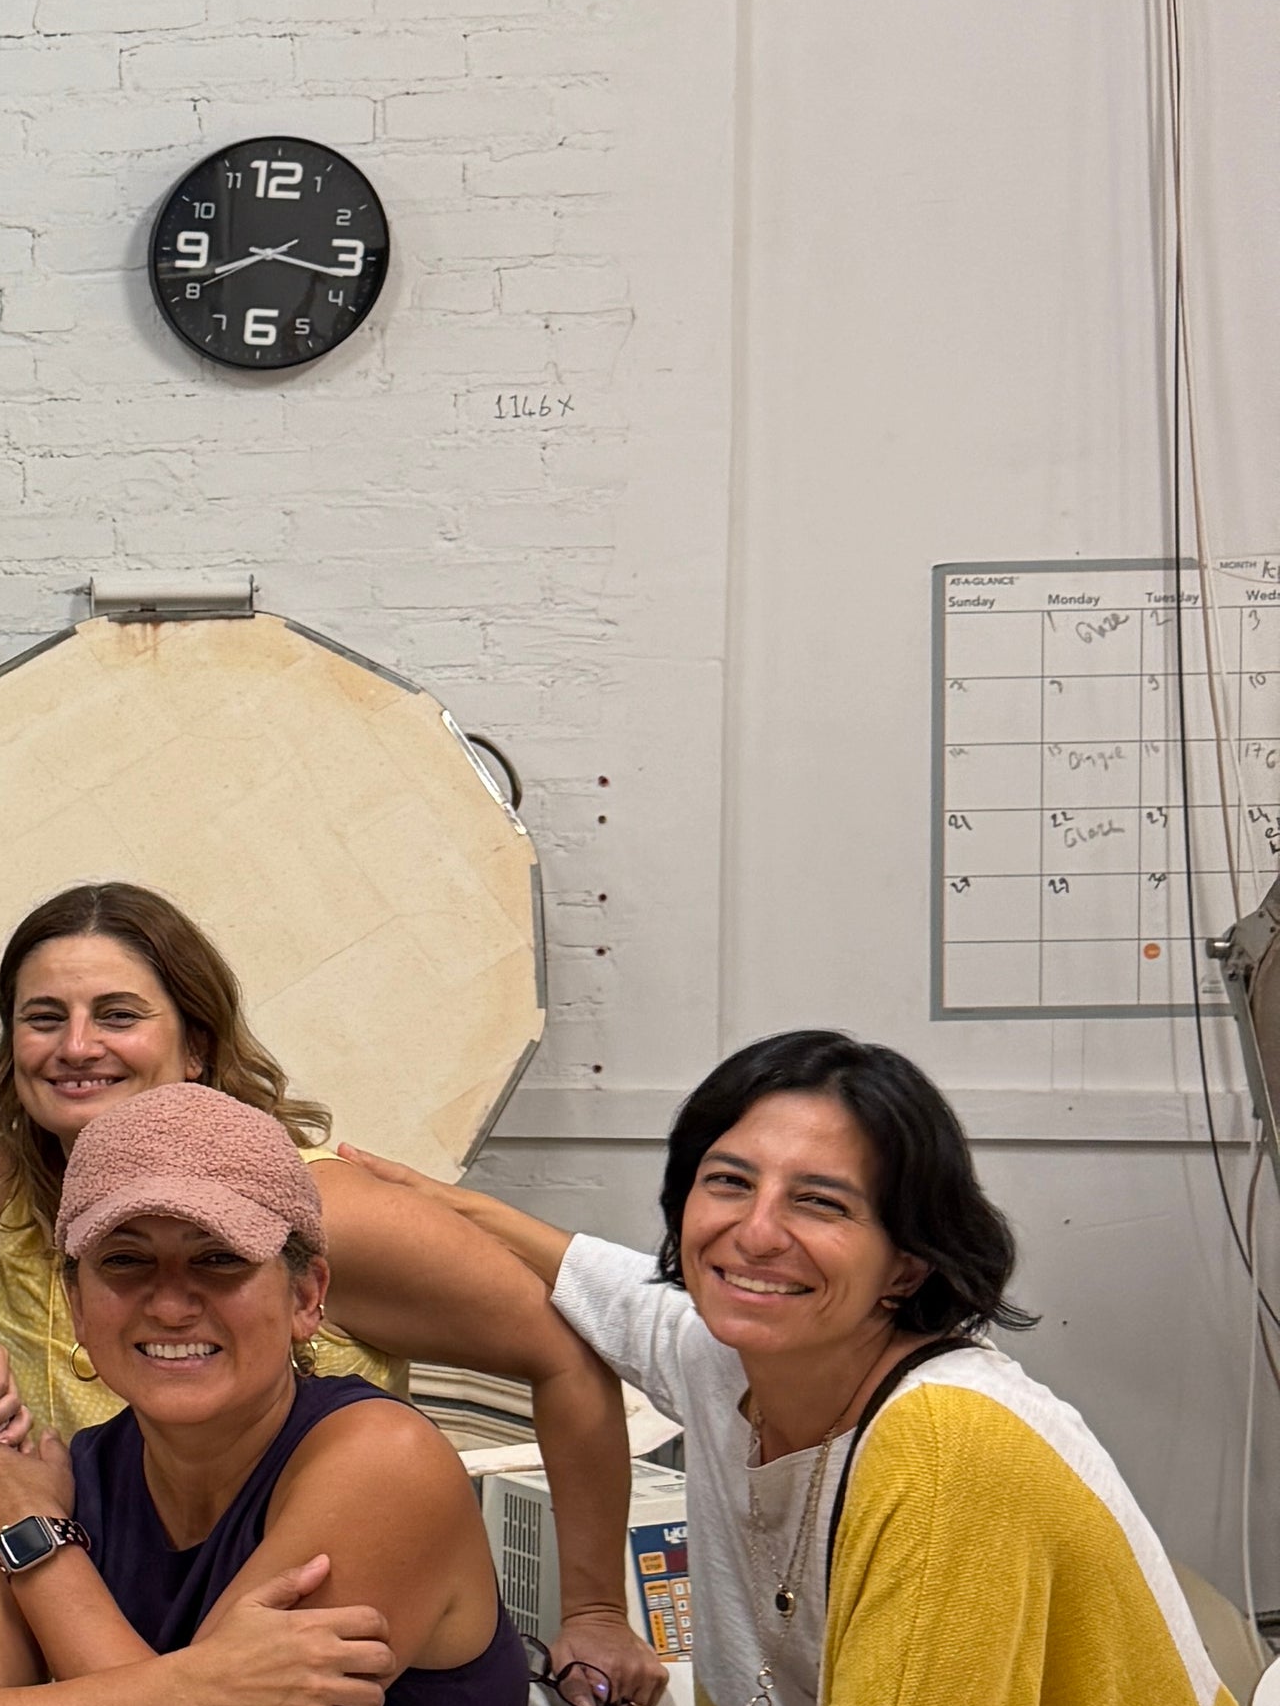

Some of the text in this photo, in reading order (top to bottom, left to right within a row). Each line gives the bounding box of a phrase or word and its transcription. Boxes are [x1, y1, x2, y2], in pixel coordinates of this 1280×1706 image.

[226, 172, 242, 189] 11
[250, 160, 303, 200] 12
[314, 176, 322, 193] 1
[193, 202, 215, 219] 10
[336, 209, 351, 226] 2
[175, 231, 209, 269] 9
[331, 239, 365, 277] 3
[185, 283, 200, 299] 8
[328, 290, 343, 306] 4
[213, 314, 227, 331] 7
[243, 308, 279, 346] 6
[295, 318, 310, 335] 5
[1219, 560, 1257, 570] MONTH
[948, 594, 996, 609] Sunday
[1047, 593, 1101, 607] Monday
[1248, 673, 1267, 689] 10
[1245, 741, 1264, 759] 17
[948, 814, 974, 831] 21
[1050, 810, 1075, 828] 22
